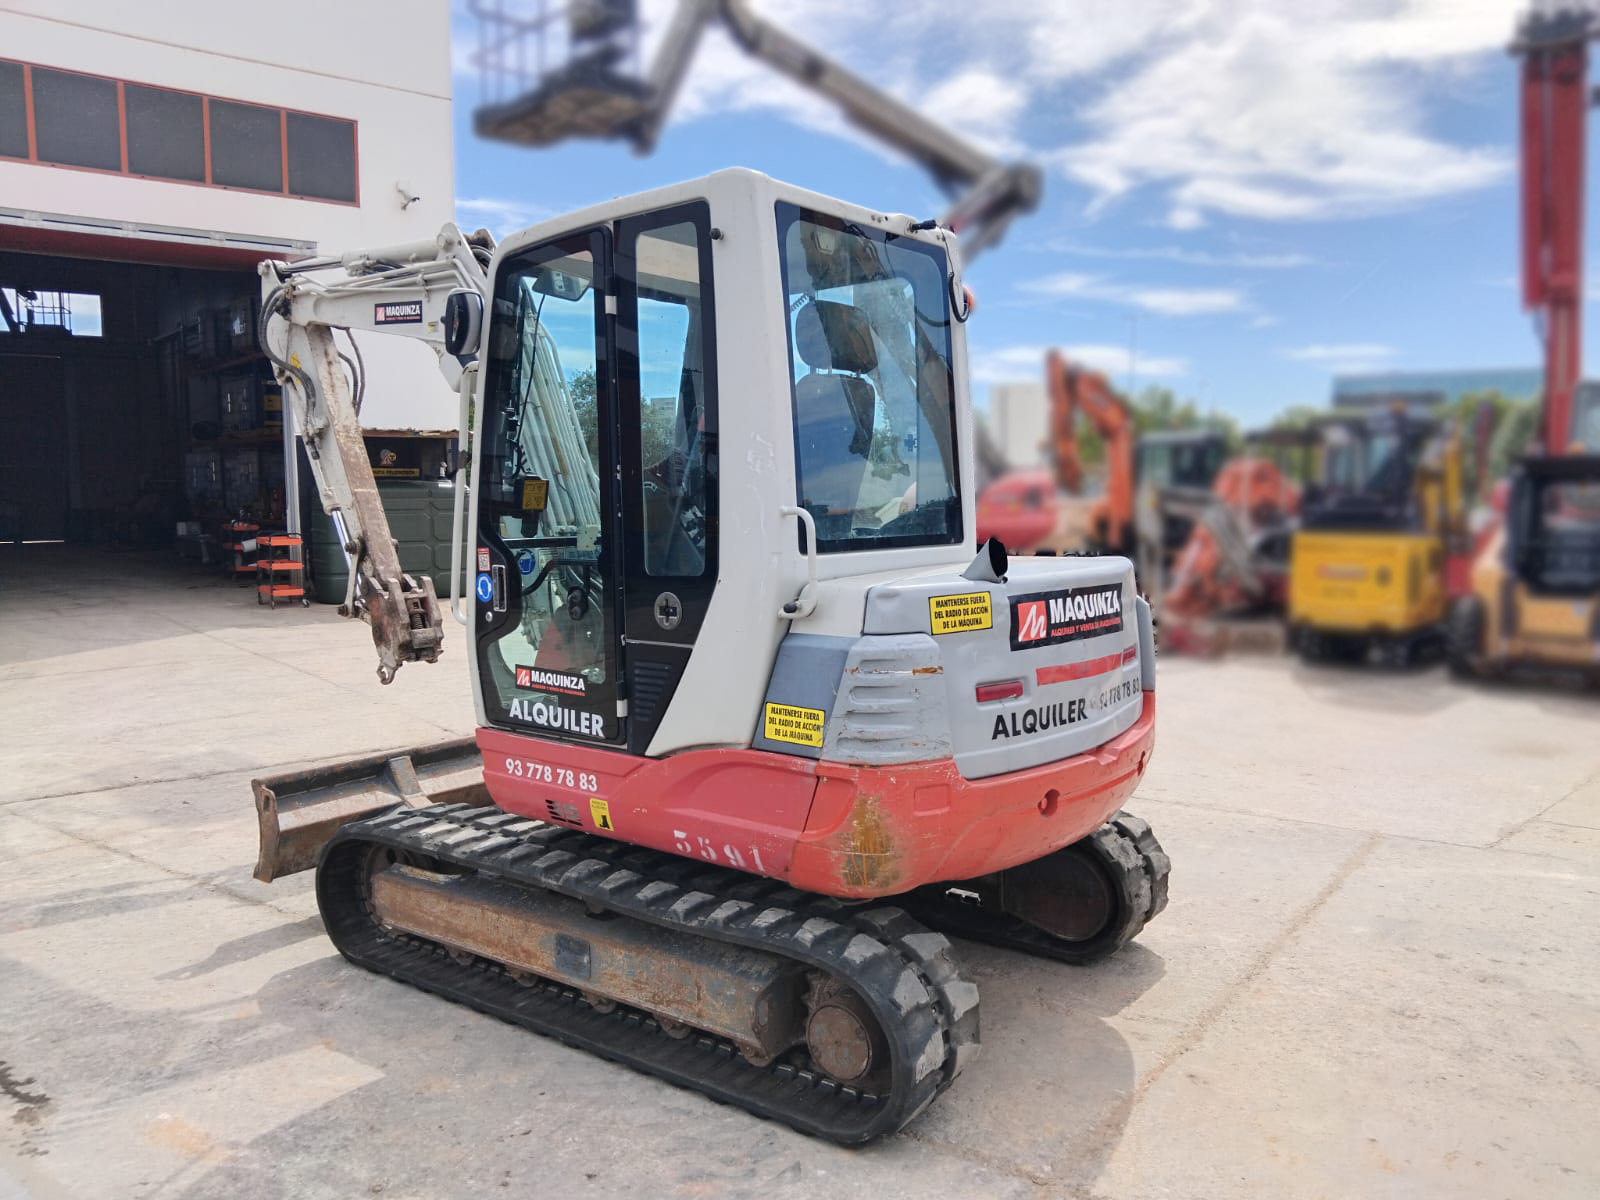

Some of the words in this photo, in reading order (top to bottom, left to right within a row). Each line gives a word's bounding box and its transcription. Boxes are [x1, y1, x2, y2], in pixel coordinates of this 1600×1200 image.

[386, 304, 420, 316] MAQUINZA
[935, 597, 969, 608] MANTENERSE
[970, 595, 986, 605] FUERA
[1049, 590, 1121, 624] MAQUINZA
[934, 611, 944, 619] DEL
[945, 608, 962, 618] RADIO
[963, 607, 970, 616] DE
[943, 620, 950, 629] DE
[951, 619, 957, 628] LA
[531, 670, 586, 691] MAQUINZA
[771, 706, 802, 718] MANTENERSE
[804, 712, 819, 720] FUERA
[992, 698, 1088, 740] ALQUILER
[1122, 680, 1131, 698] 78
[509, 697, 605, 738] ALQUILER
[779, 719, 793, 727] RADIO
[505, 758, 523, 777] 93
[526, 762, 553, 783] 778
[556, 768, 575, 788] 78
[579, 772, 598, 792] 83
